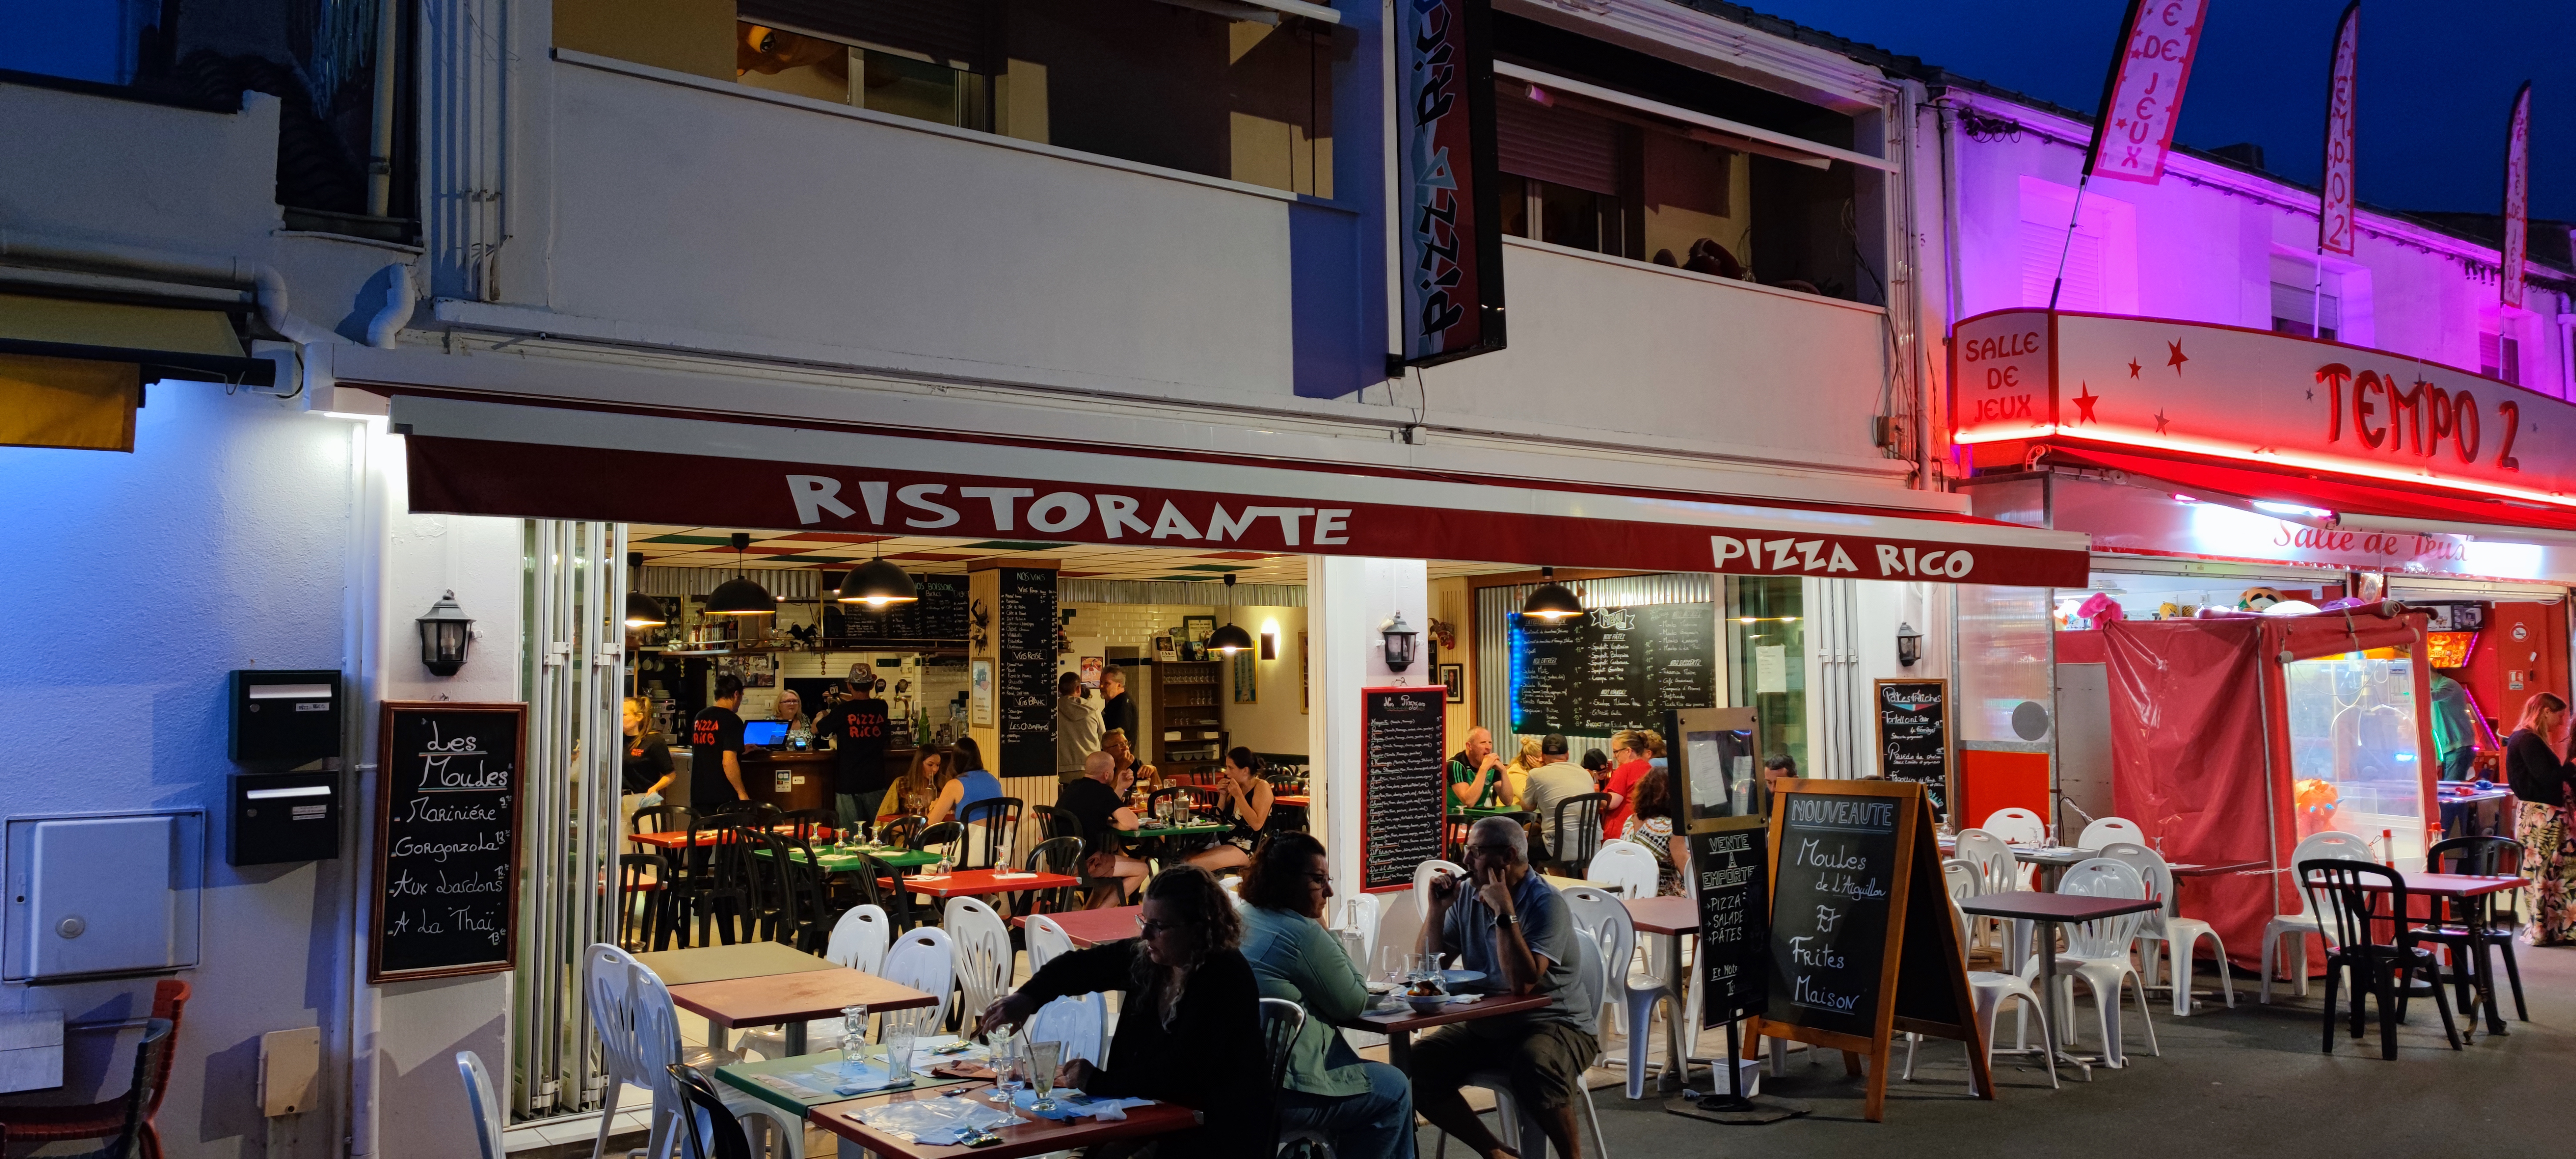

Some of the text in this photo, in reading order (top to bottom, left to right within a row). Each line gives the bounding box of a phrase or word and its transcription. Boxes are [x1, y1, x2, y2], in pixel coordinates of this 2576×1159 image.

[2143, 35, 2181, 61] DE
[1413, 0, 1456, 134] RIC
[2121, 72, 2157, 169] JEUX
[2329, 214, 2345, 246] 2
[1416, 146, 1465, 345] PIZZA
[1965, 332, 2040, 362] SALLE
[1987, 367, 2019, 391] DE
[1974, 394, 2033, 421] JEUX
[2317, 363, 2520, 472] TEMPO 2
[785, 474, 1353, 546] RISTORANTE
[2274, 519, 2355, 552] Salle
[1711, 535, 1974, 578] PIZZA RICO
[1017, 572, 1030, 581] NOS
[1603, 612, 1623, 626] MENU
[694, 720, 719, 731] PIZZA
[847, 713, 884, 725] PIZZA
[849, 726, 882, 738] RICO
[427, 720, 476, 752] Les
[419, 755, 508, 787] Moules
[1791, 800, 1893, 826] NOUVEAUTE
[396, 832, 500, 862] Gorgonzola
[1709, 834, 1750, 852] VENTE
[1797, 837, 1866, 870] Moules
[1729, 852, 1736, 866] A
[393, 869, 428, 897] Aux
[436, 870, 503, 894] Lardons
[1702, 865, 1755, 887] EMPORTE
[1815, 872, 1829, 891] de
[1711, 894, 1741, 911] PIZZA
[393, 911, 410, 936] A
[418, 908, 444, 933] La
[1817, 904, 1841, 932] Et
[1711, 926, 1742, 945] PÂTES
[1789, 936, 1844, 968] Frites
